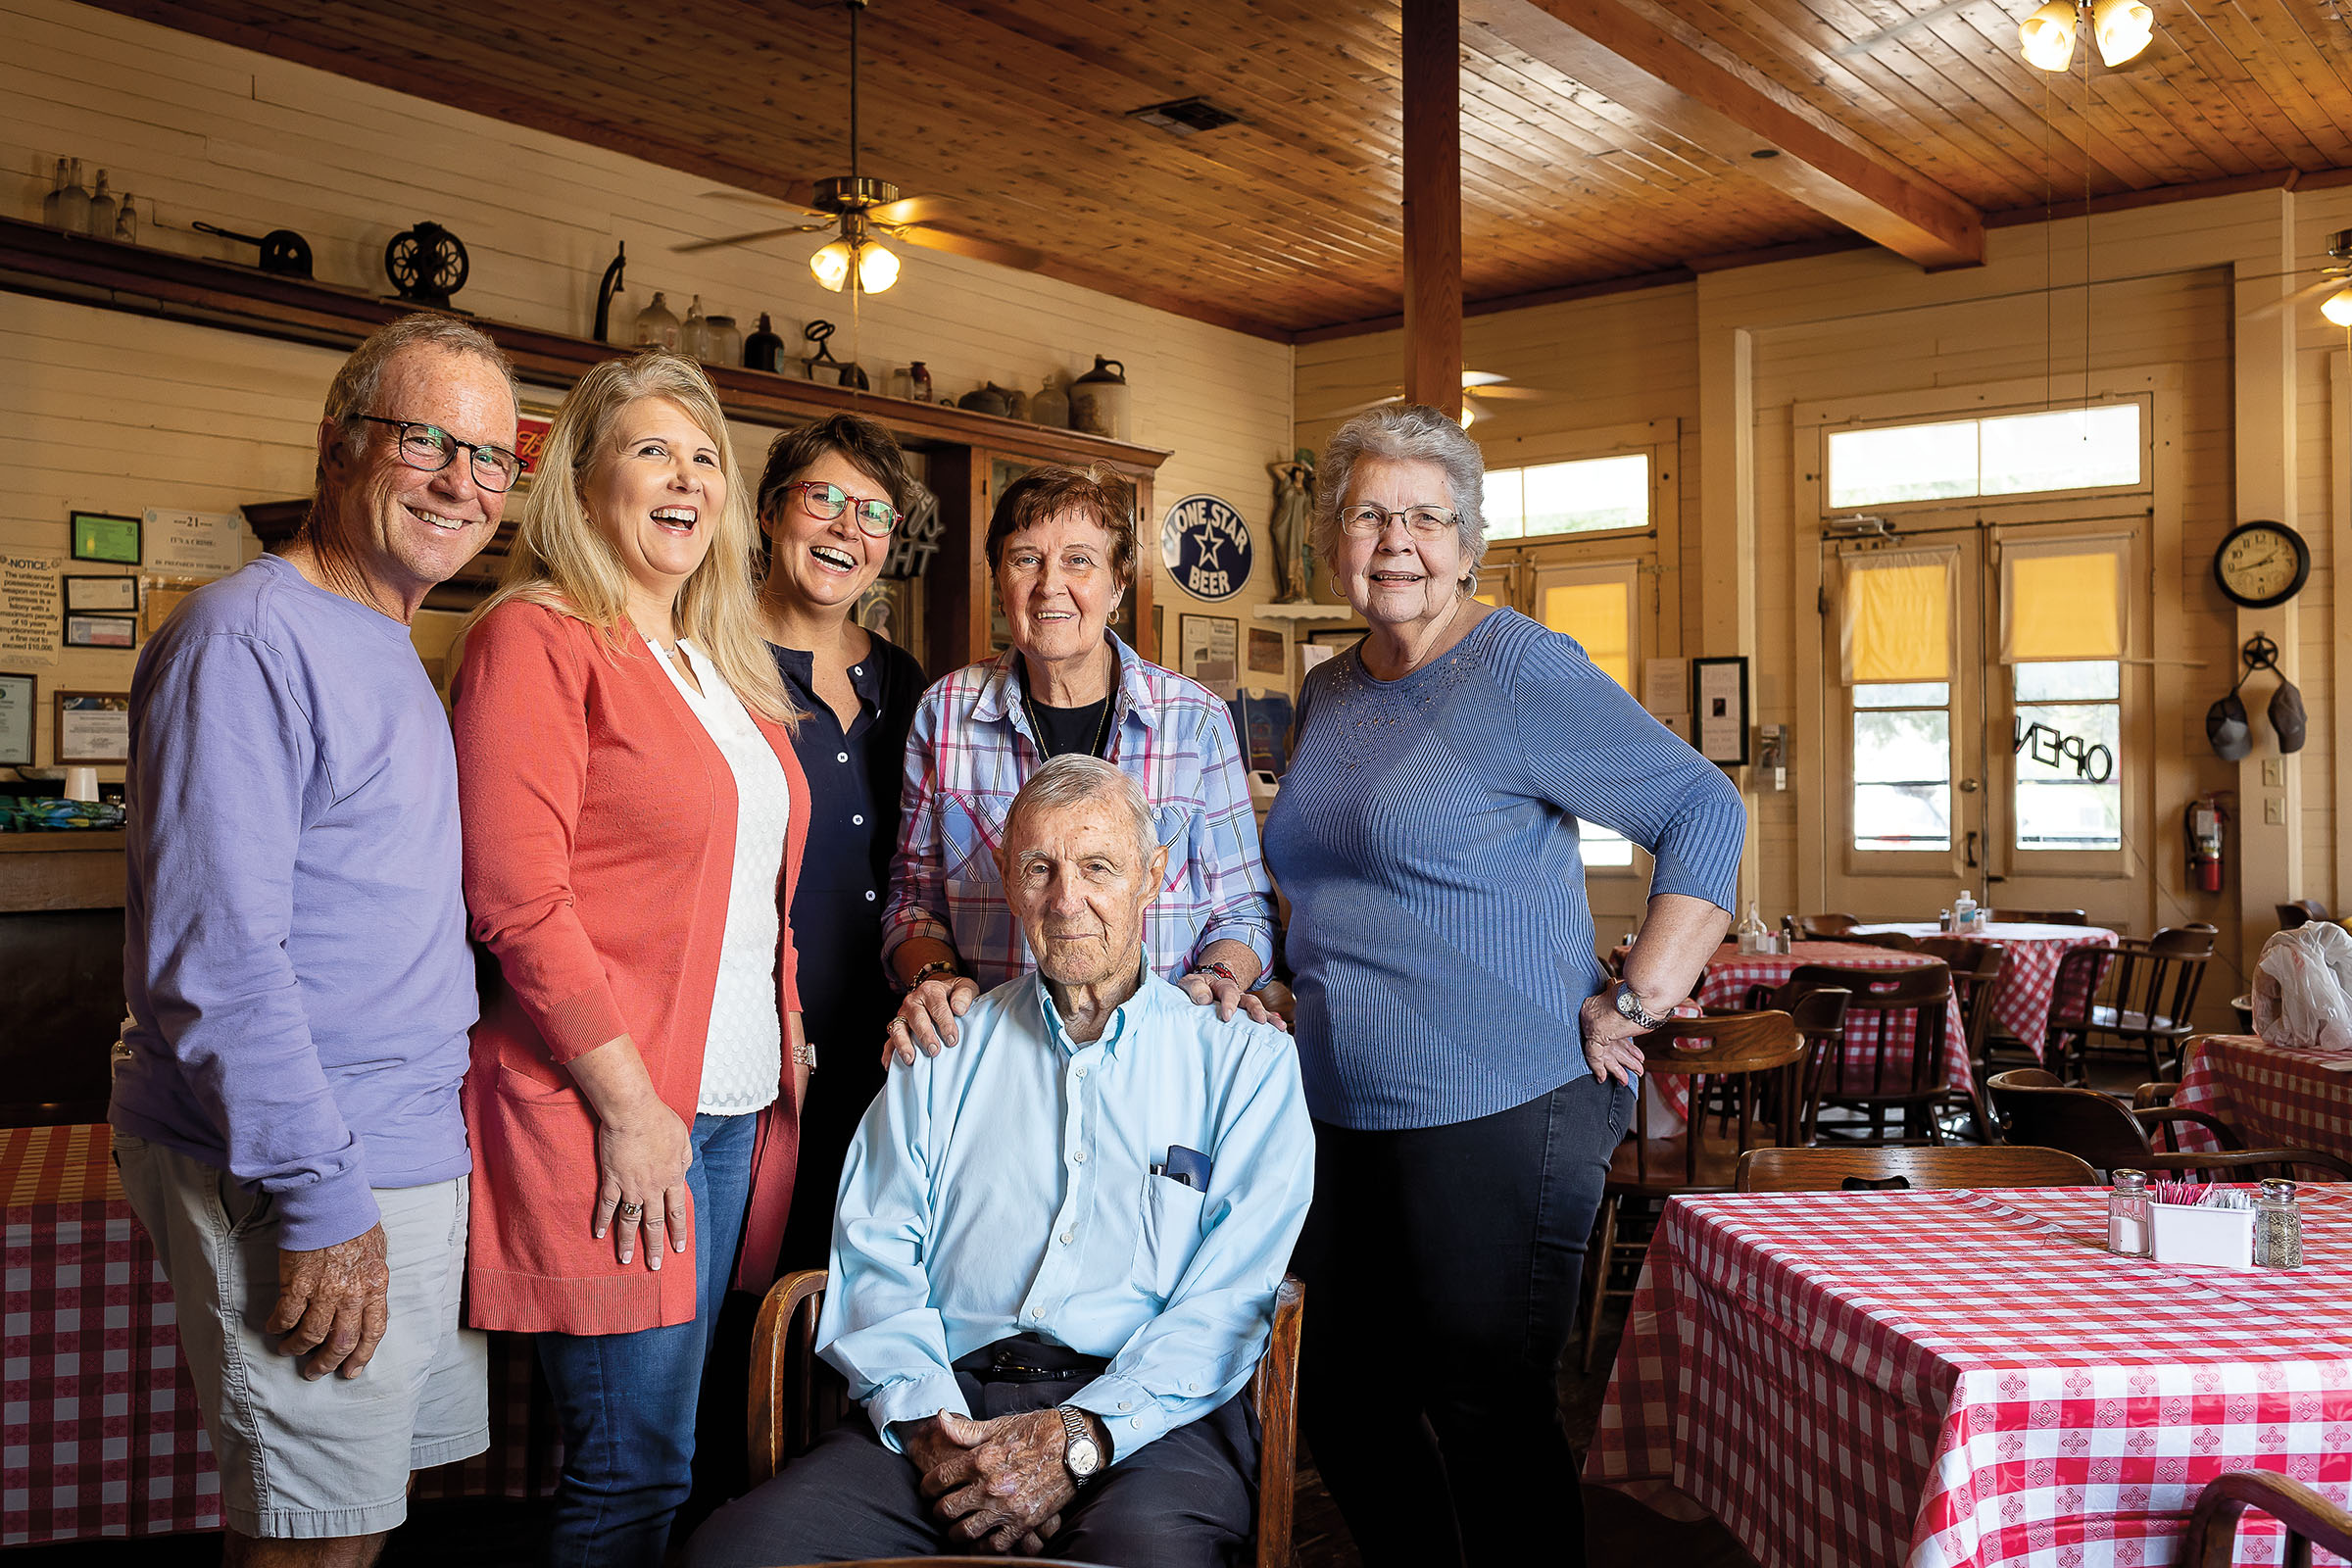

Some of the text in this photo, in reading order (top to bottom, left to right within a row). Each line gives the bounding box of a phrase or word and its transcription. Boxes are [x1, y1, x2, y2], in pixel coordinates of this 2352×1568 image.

[187, 515, 198, 527] 21
[1167, 501, 1248, 555] LONE STAR
[1189, 565, 1231, 596] BEER
